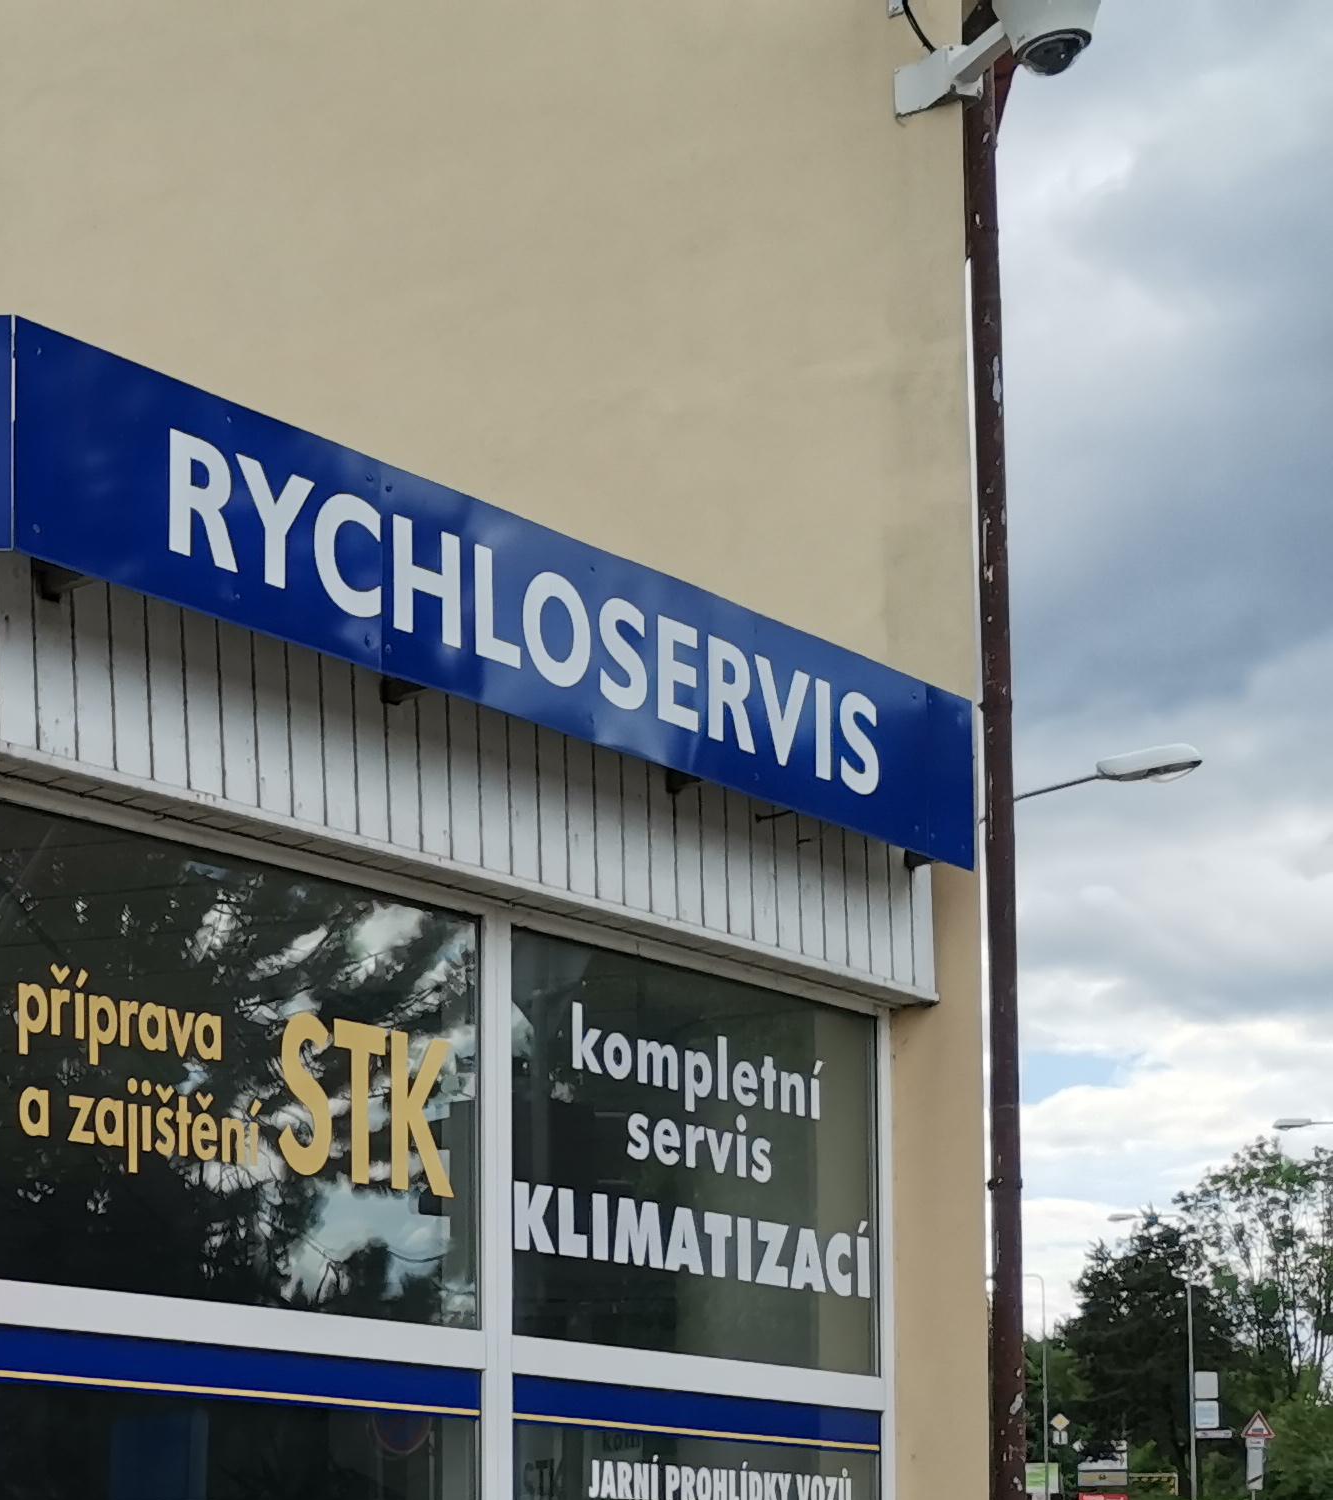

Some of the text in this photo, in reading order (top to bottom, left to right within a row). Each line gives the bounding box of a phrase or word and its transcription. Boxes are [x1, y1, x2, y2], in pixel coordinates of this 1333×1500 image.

[168, 428, 880, 796] RYCHLOSERVIS
[18, 964, 222, 1066] příprava
[572, 1001, 826, 1121] kompletní
[18, 1079, 263, 1174] a zajištění
[278, 1012, 455, 1199] STK
[626, 1113, 773, 1184] servis
[513, 1180, 872, 1299] KLIMATIZACÍ
[589, 1455, 659, 1500] JARNÍ
